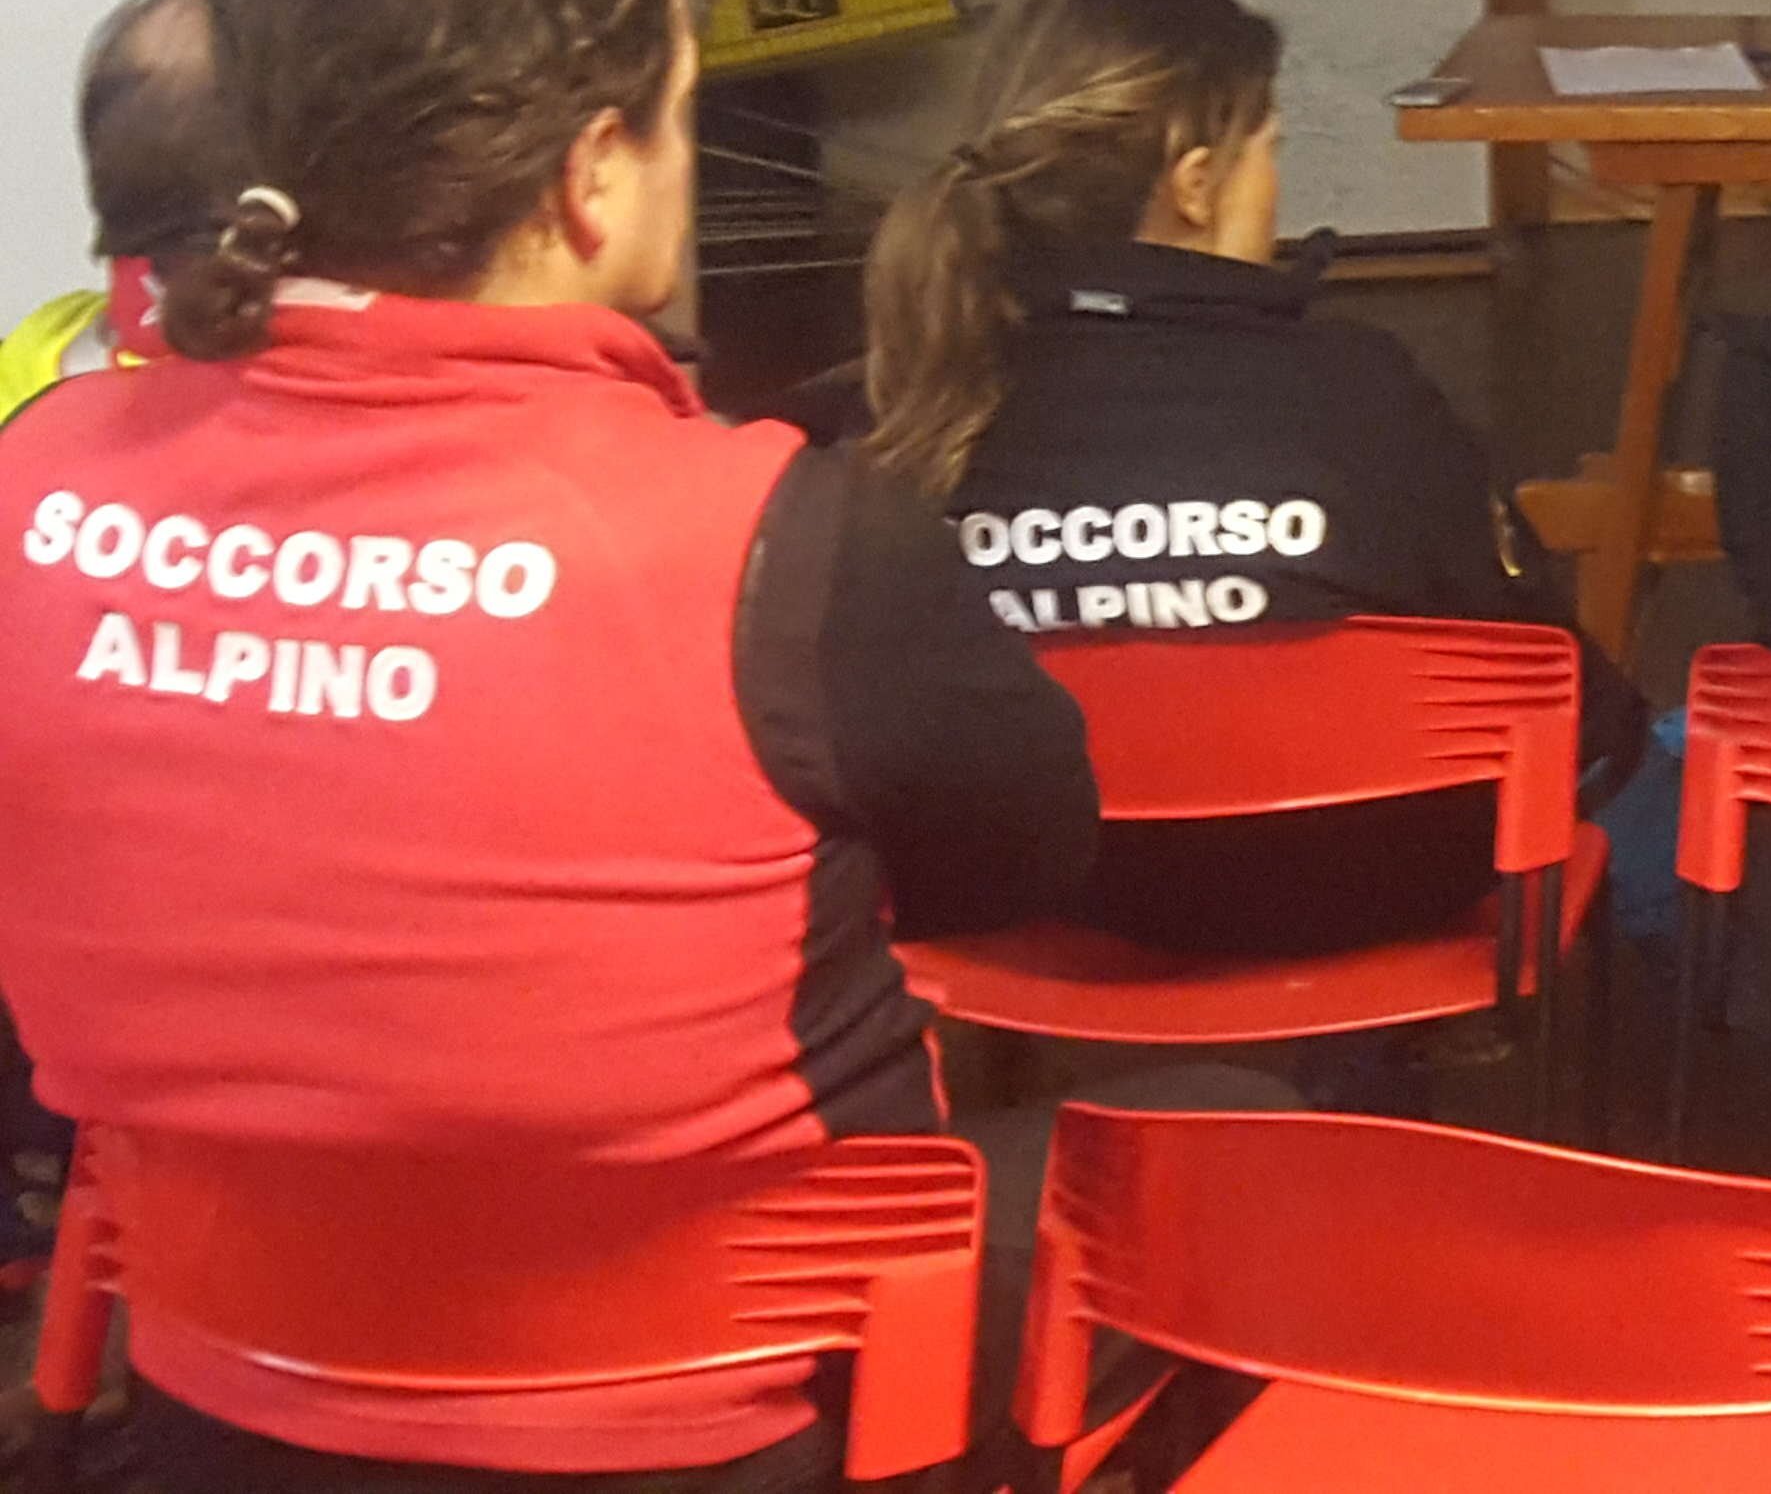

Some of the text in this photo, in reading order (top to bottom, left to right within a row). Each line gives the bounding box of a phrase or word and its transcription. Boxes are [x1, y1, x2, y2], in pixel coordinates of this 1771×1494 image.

[23, 490, 557, 618] SOCCORSO
[950, 499, 1328, 567] OCCORSO
[76, 610, 439, 722] ALPINO
